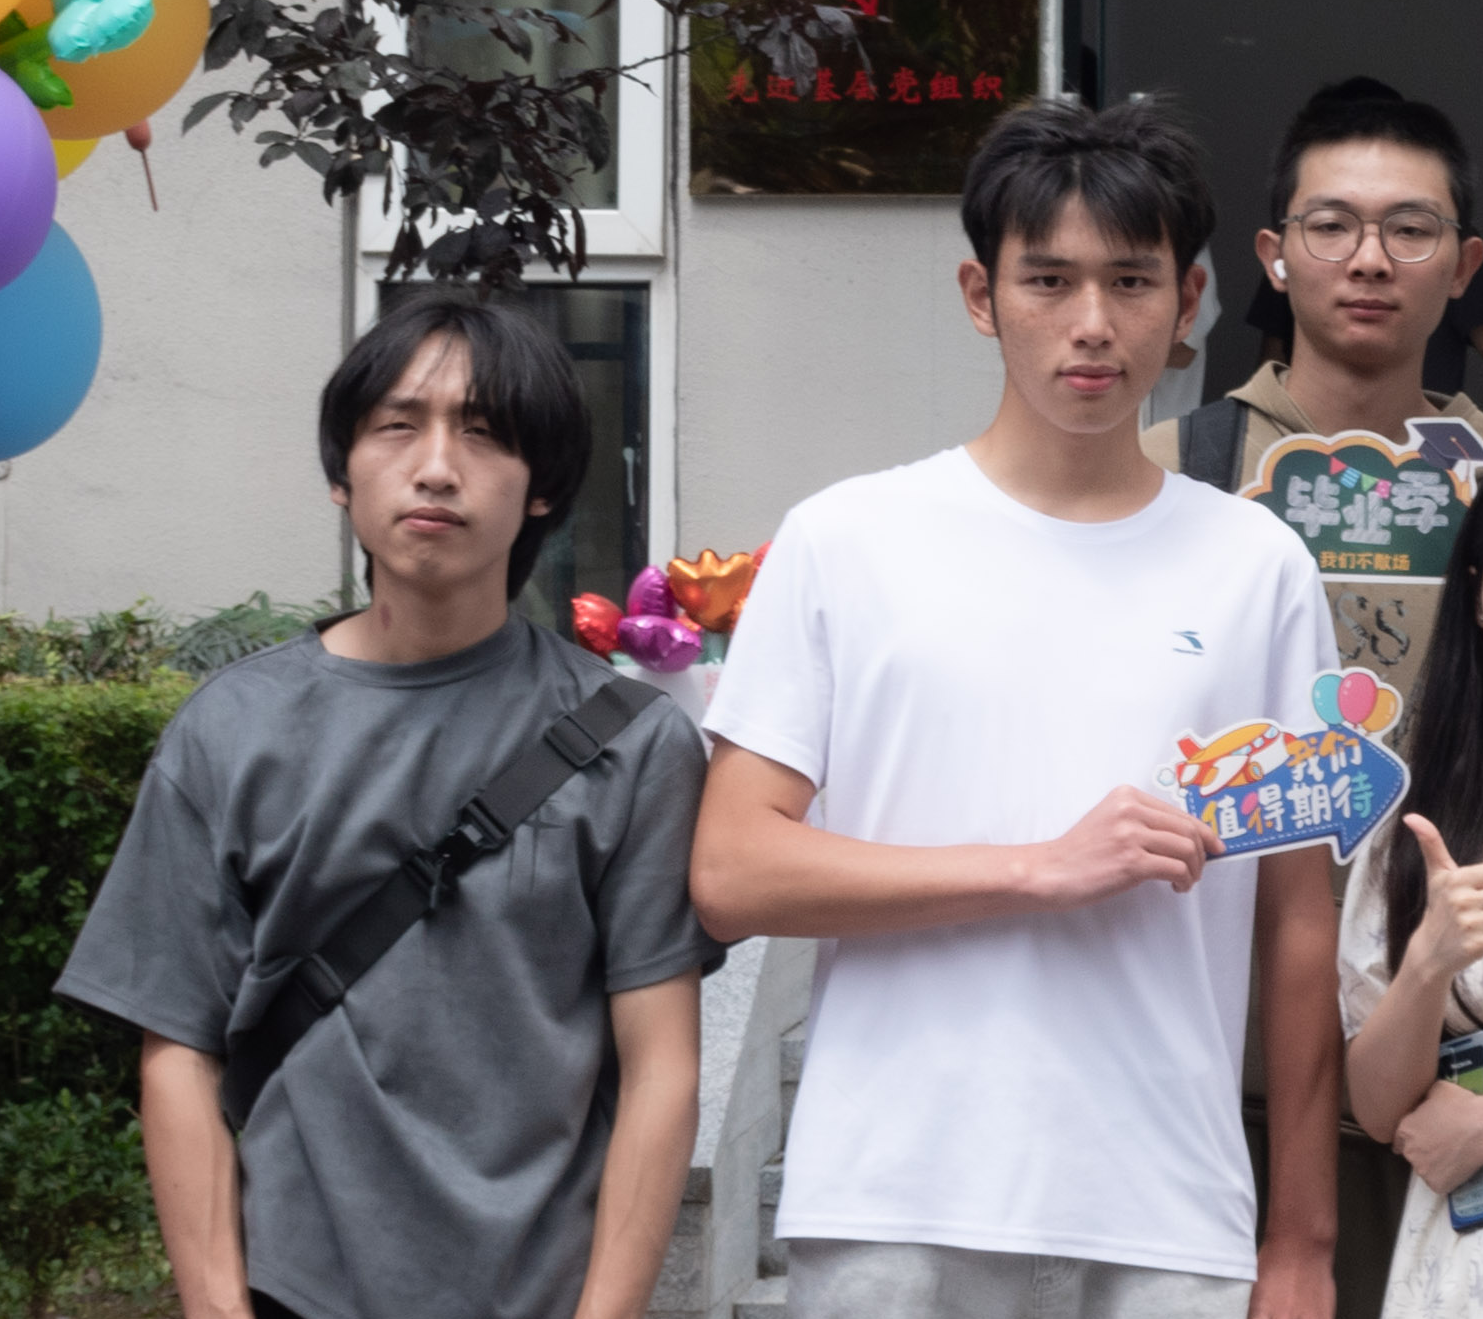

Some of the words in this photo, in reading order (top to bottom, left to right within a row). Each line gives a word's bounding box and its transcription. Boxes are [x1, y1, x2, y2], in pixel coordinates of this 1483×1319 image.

[726, 66, 1005, 104] 先进基层党组织
[1286, 470, 1450, 545] 毕业季
[1319, 550, 1411, 571] 我们不散场
[1286, 731, 1362, 782] 我们
[1201, 771, 1374, 840] 值得期待
